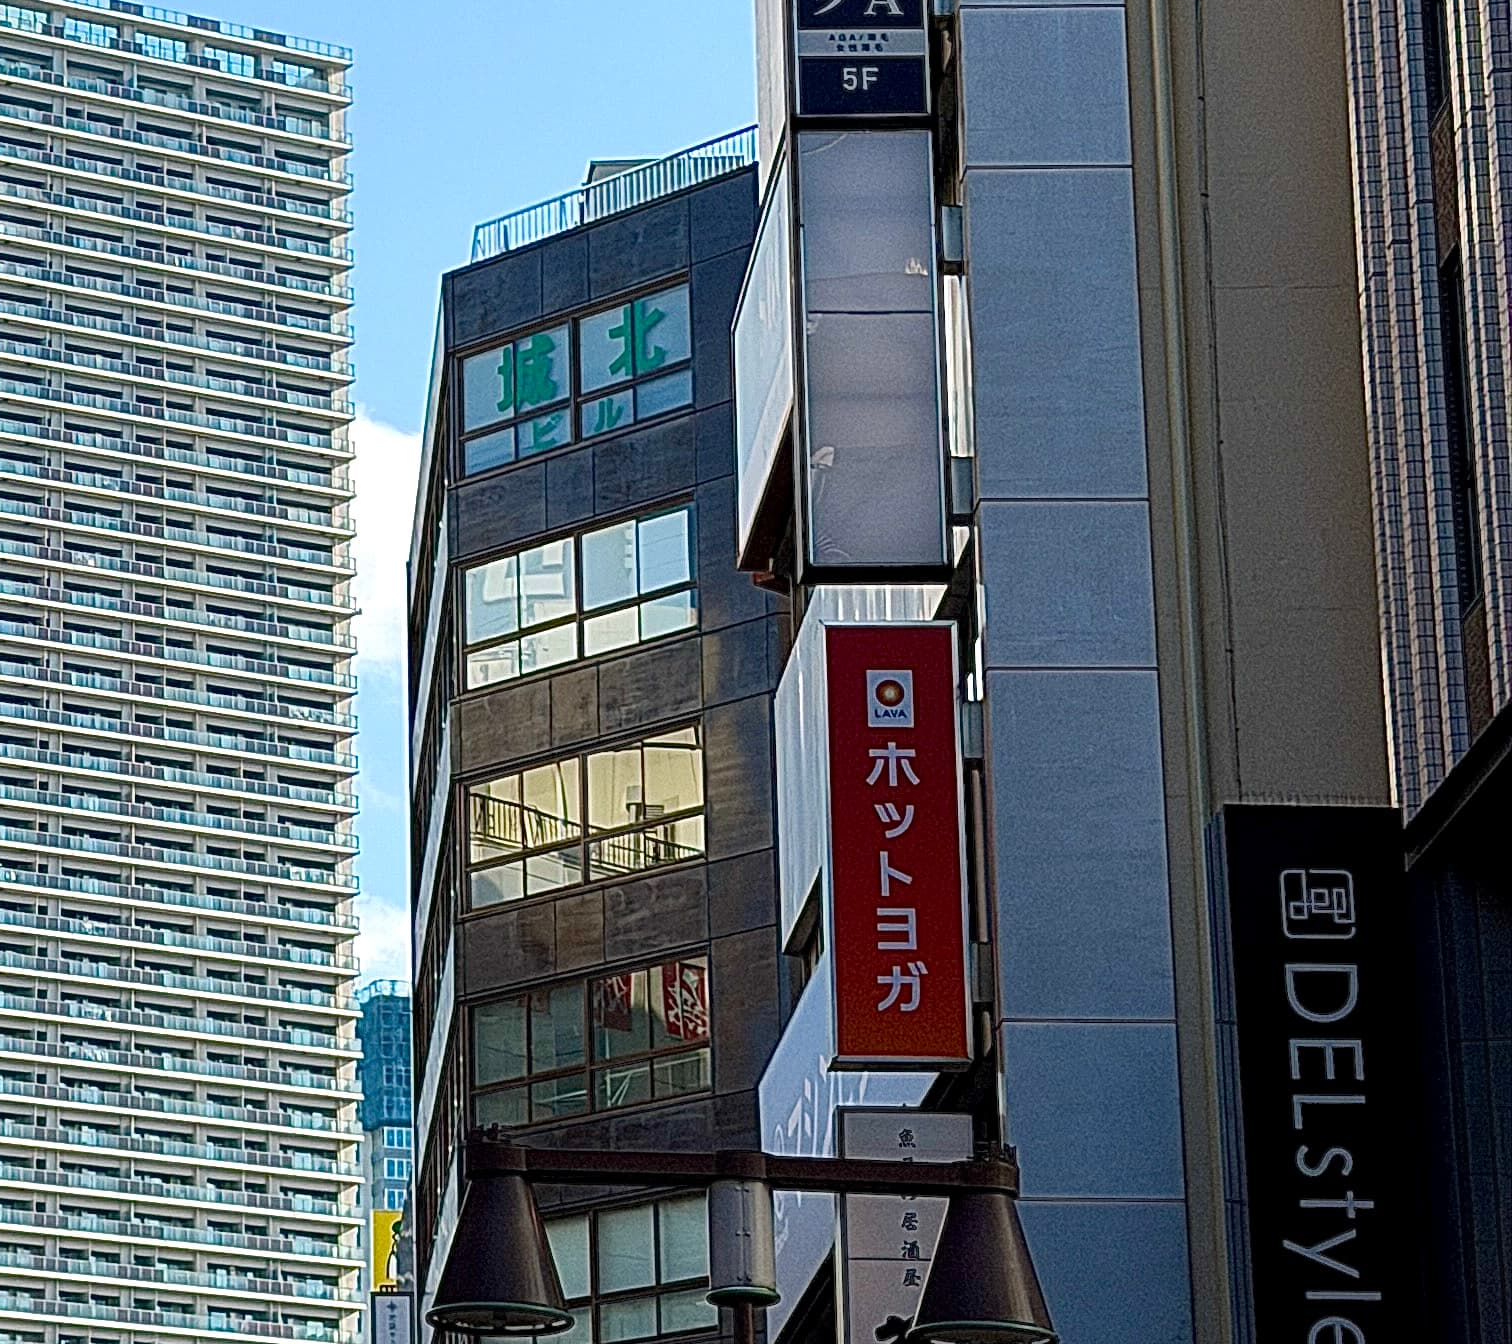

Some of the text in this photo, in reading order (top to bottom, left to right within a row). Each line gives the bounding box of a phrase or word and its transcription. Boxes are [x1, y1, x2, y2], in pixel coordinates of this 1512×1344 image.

[842, 66, 880, 91] 5F
[529, 397, 624, 451] ビル
[865, 741, 929, 1015] ホットヨガ
[897, 1128, 921, 1287] 魚居酒屋
